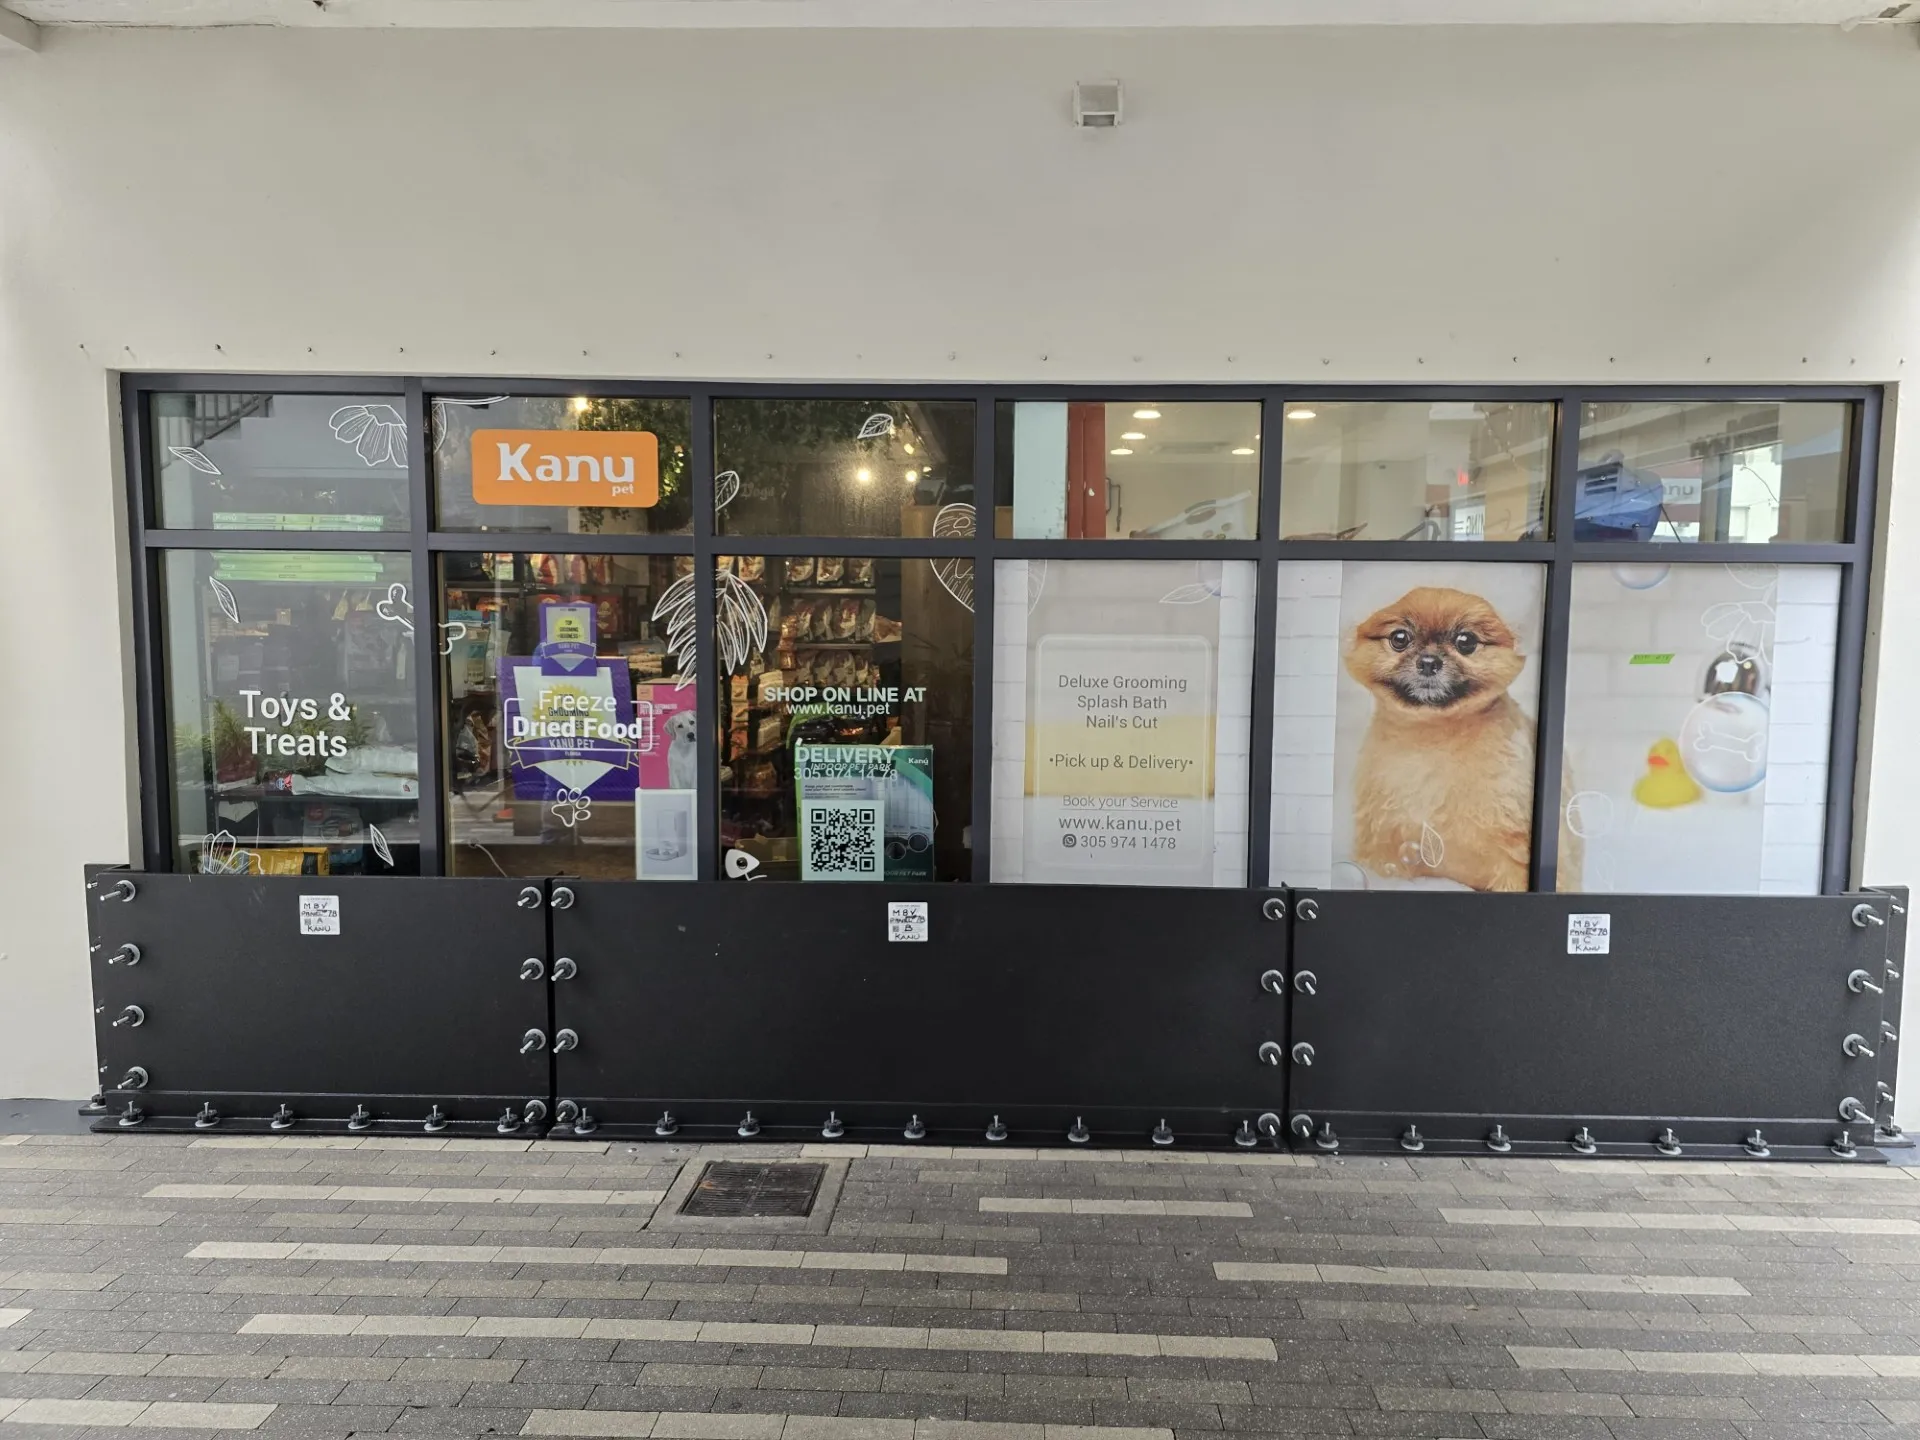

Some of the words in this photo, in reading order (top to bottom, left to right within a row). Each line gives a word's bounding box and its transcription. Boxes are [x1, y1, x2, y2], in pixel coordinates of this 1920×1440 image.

[496, 442, 634, 483] Kanu
[612, 484, 634, 497] pet
[1058, 674, 1109, 688] Deluxe
[1113, 675, 1187, 693] Grooming
[539, 690, 617, 712] Freeze
[764, 687, 818, 702] SHOP
[822, 687, 850, 702] ON
[857, 687, 899, 702] LINE
[903, 687, 927, 702] AT
[1077, 694, 1128, 711] Splash
[1133, 695, 1167, 709] Bath
[239, 690, 318, 727] Toys
[328, 692, 351, 721] &
[786, 702, 890, 717] www.kanu.pet
[512, 716, 576, 738] Dried
[584, 718, 642, 739] Food
[1086, 714, 1128, 729] Nail's
[1132, 715, 1158, 729] Cut
[244, 727, 347, 757] Treats
[549, 738, 574, 748] KANU
[577, 739, 594, 749] PET
[795, 747, 896, 763] DELIVERY
[1090, 758, 1109, 771] up
[1113, 754, 1124, 768] &
[794, 767, 820, 780] 305
[825, 767, 853, 780] 974
[859, 767, 874, 780] 14
[880, 768, 898, 781] 78
[1062, 795, 1095, 807] Book
[1098, 797, 1127, 810] your
[1130, 796, 1178, 809] Service
[1058, 816, 1181, 834] www.kanu.pet
[1080, 835, 1106, 848] 305
[1110, 836, 1136, 849] 974
[1142, 837, 1176, 849] 1478
